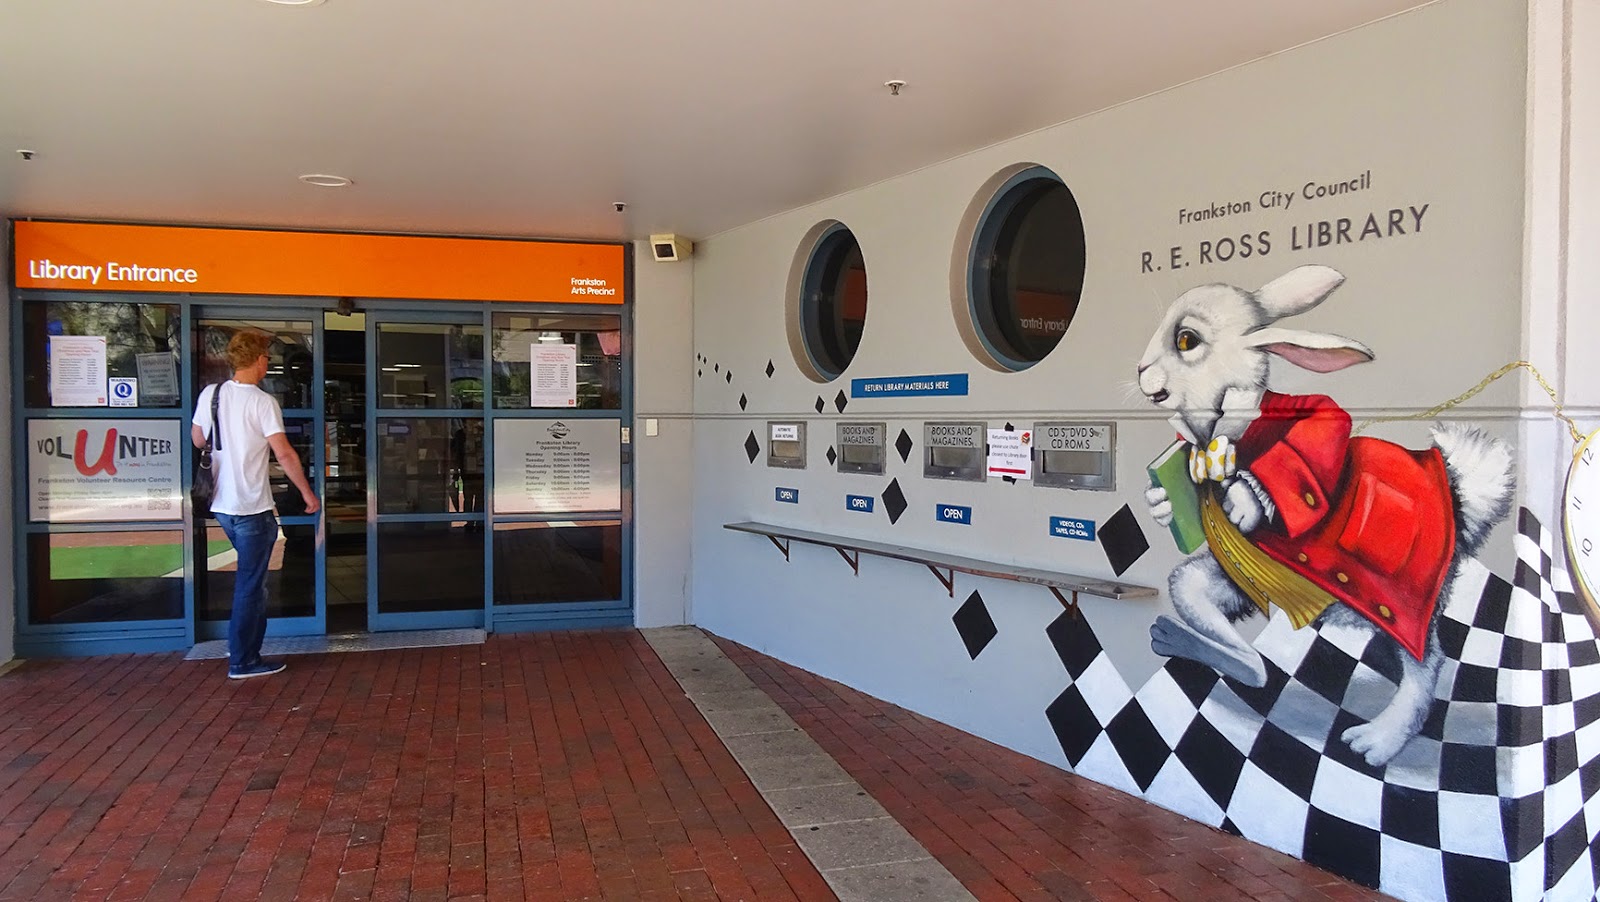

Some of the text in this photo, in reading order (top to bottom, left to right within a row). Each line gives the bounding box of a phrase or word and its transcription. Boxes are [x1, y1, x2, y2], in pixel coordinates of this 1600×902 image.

[1179, 170, 1370, 225] Frankston City Council
[1141, 204, 1429, 274] R. E. ROSS LIBRARY
[29, 260, 198, 284] Library Entrance
[571, 277, 606, 286] Frankston
[571, 287, 616, 296] Arts Precinct
[864, 381, 949, 392] RETURN LIBRARY MATERIALS HERE
[843, 426, 875, 435] BOOKS AND
[931, 426, 973, 436] BOOKS AND
[843, 436, 875, 444] MAGAZINES
[932, 437, 972, 446] MAGAZINES
[1051, 439, 1063, 449] CD
[37, 428, 172, 476] VOLUNTEER
[1581, 447, 1595, 466] 12
[779, 491, 793, 500] OPEN
[852, 499, 868, 509] OPEN
[1572, 496, 1583, 511] 11
[943, 508, 963, 520] OPEN
[1058, 520, 1076, 529] VIDEOS,
[1581, 538, 1594, 558] 10
